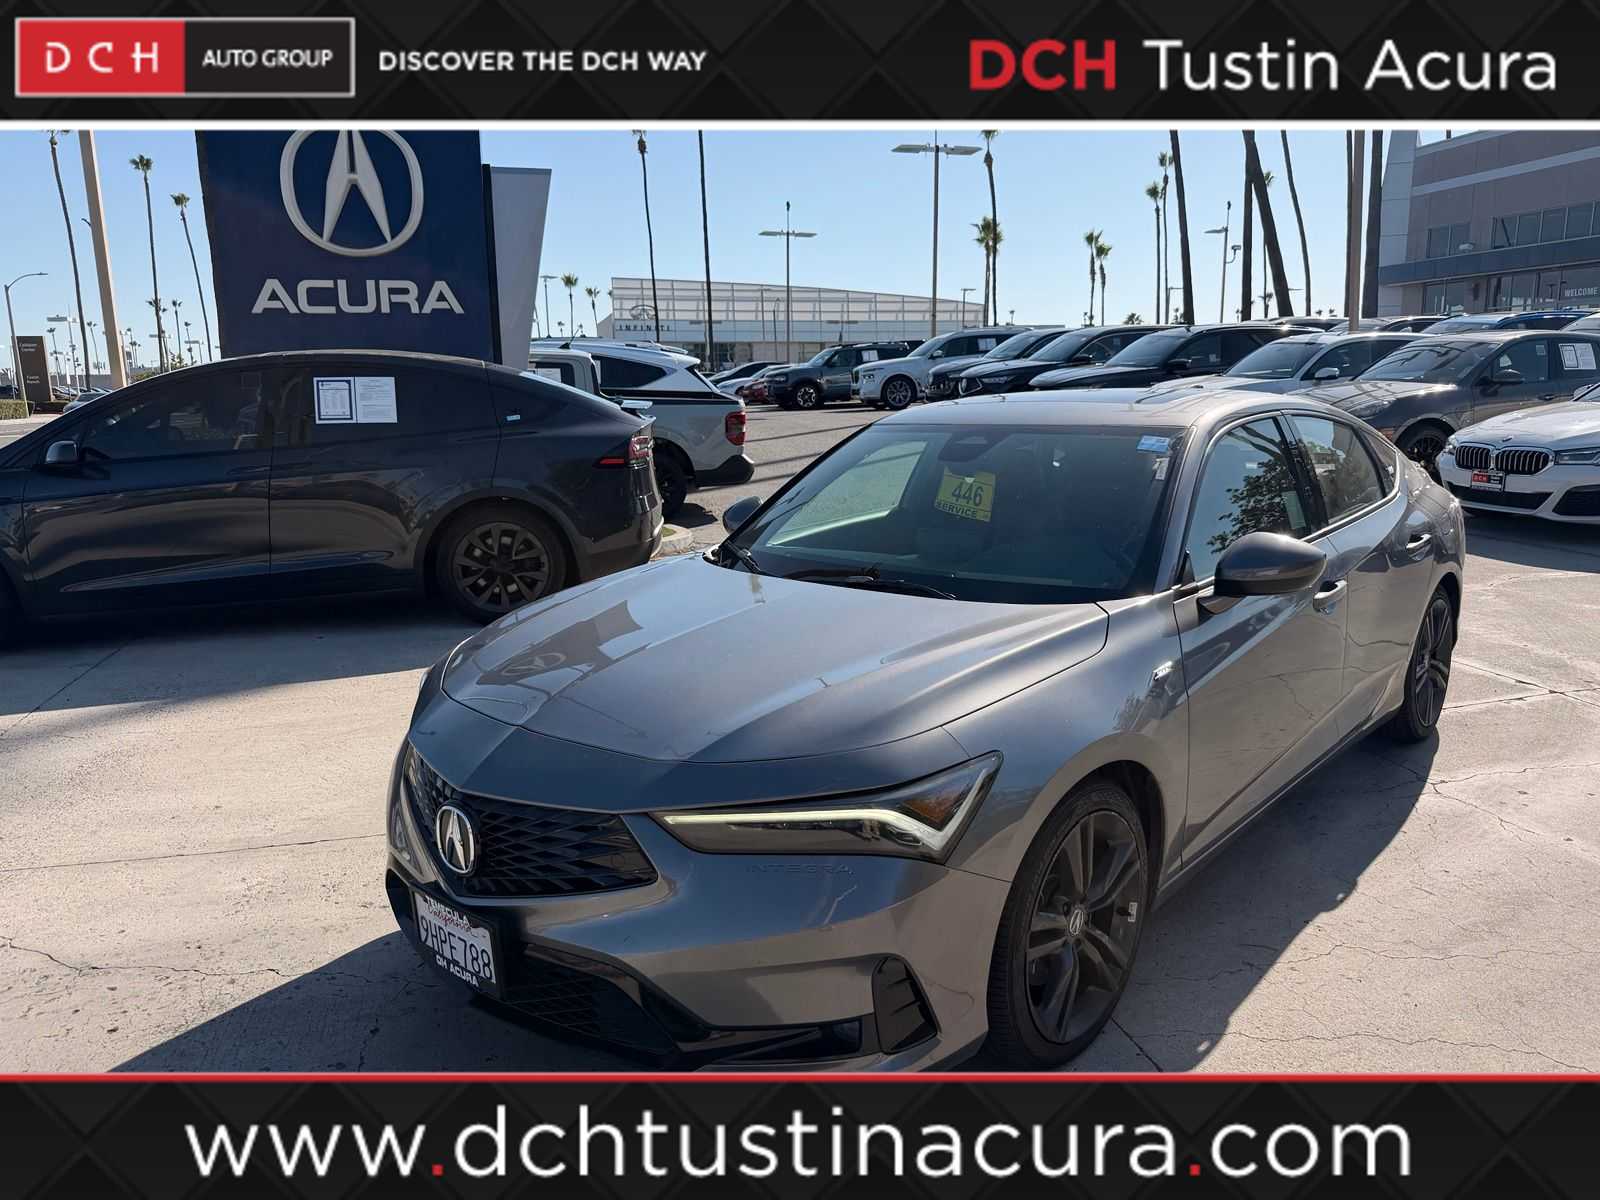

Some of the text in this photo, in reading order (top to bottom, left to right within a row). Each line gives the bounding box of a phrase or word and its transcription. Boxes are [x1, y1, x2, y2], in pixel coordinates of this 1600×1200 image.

[251, 278, 465, 314] ACURA
[1564, 287, 1599, 297] WELCOME
[951, 481, 984, 506] 446
[935, 501, 977, 519] SERVICE
[419, 916, 494, 981] 9HPE788
[449, 962, 480, 987] ACURA
